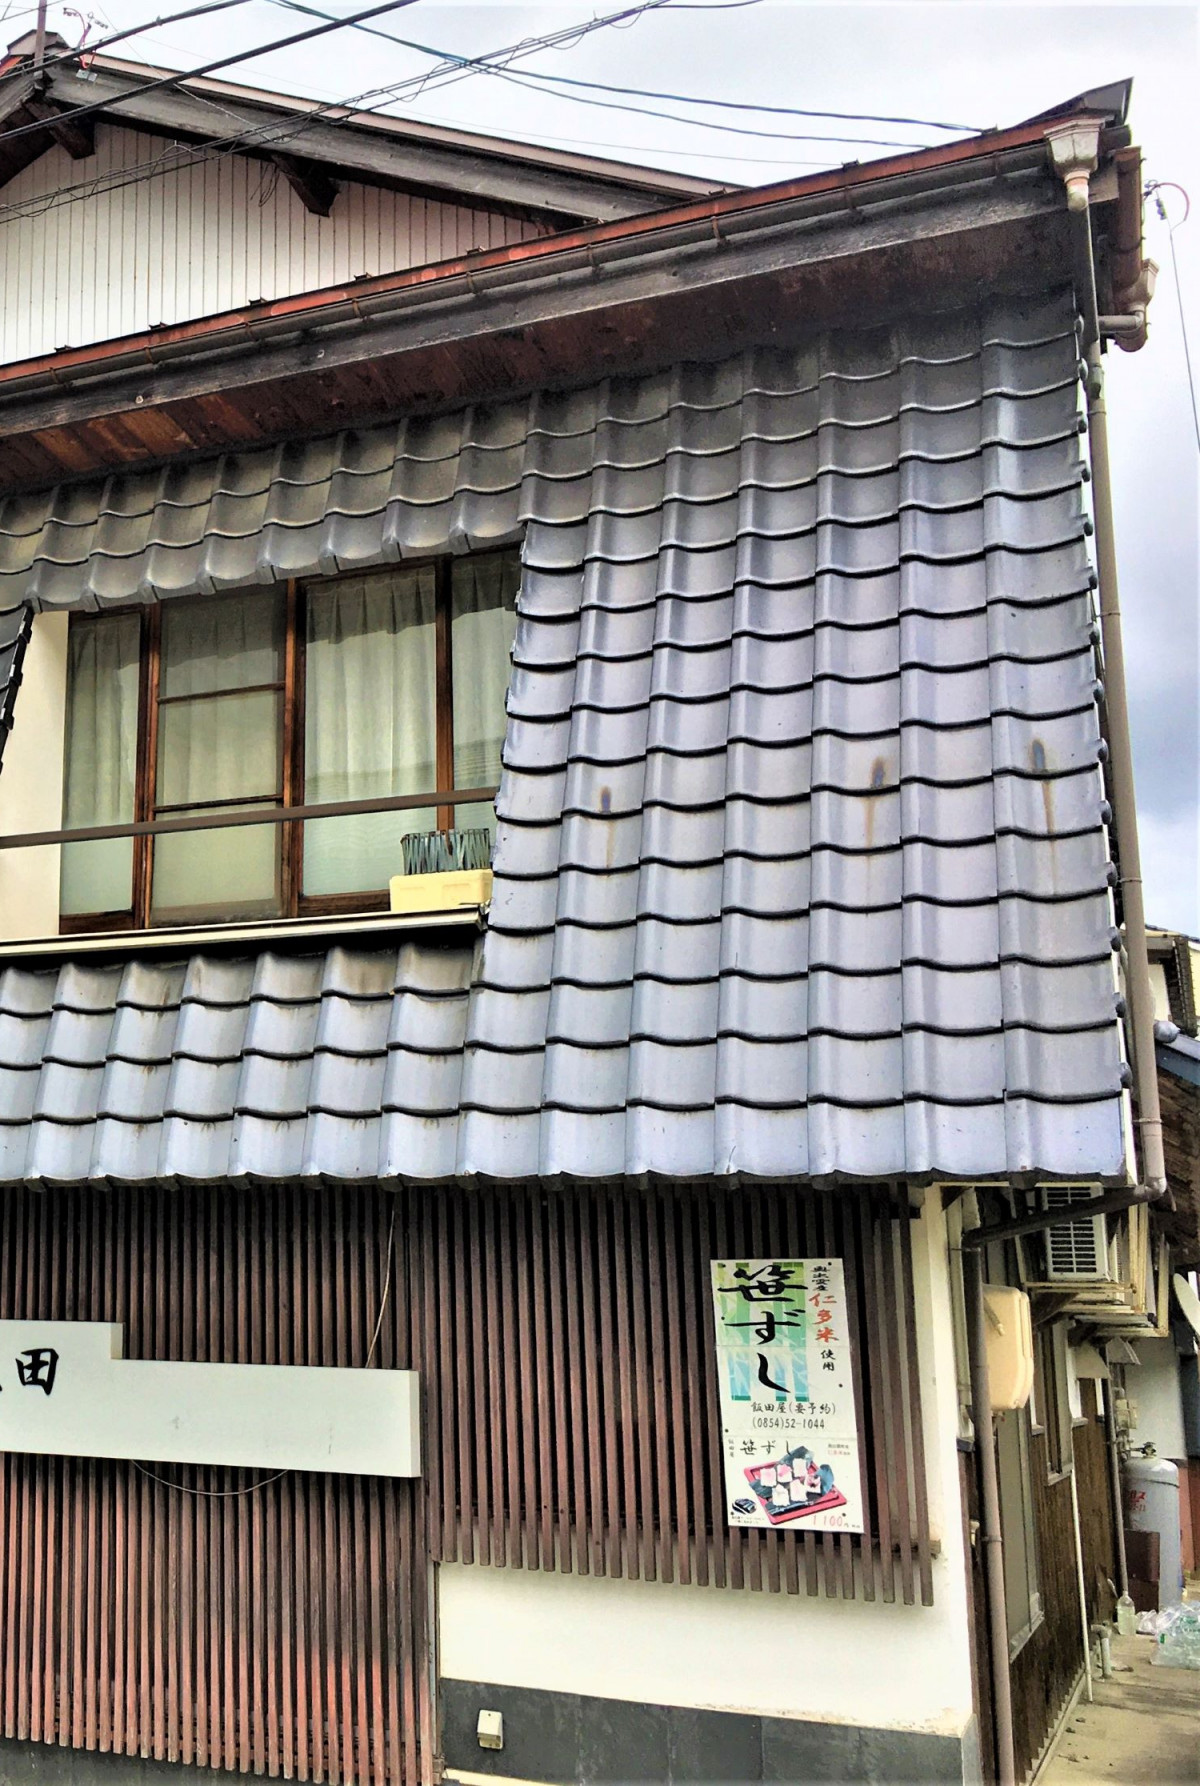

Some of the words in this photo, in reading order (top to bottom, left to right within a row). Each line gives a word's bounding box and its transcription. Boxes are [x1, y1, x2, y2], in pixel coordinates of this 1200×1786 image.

[717, 1264, 809, 1394] 笹ずし
[752, 1416, 825, 1429] (0854)52-1044
